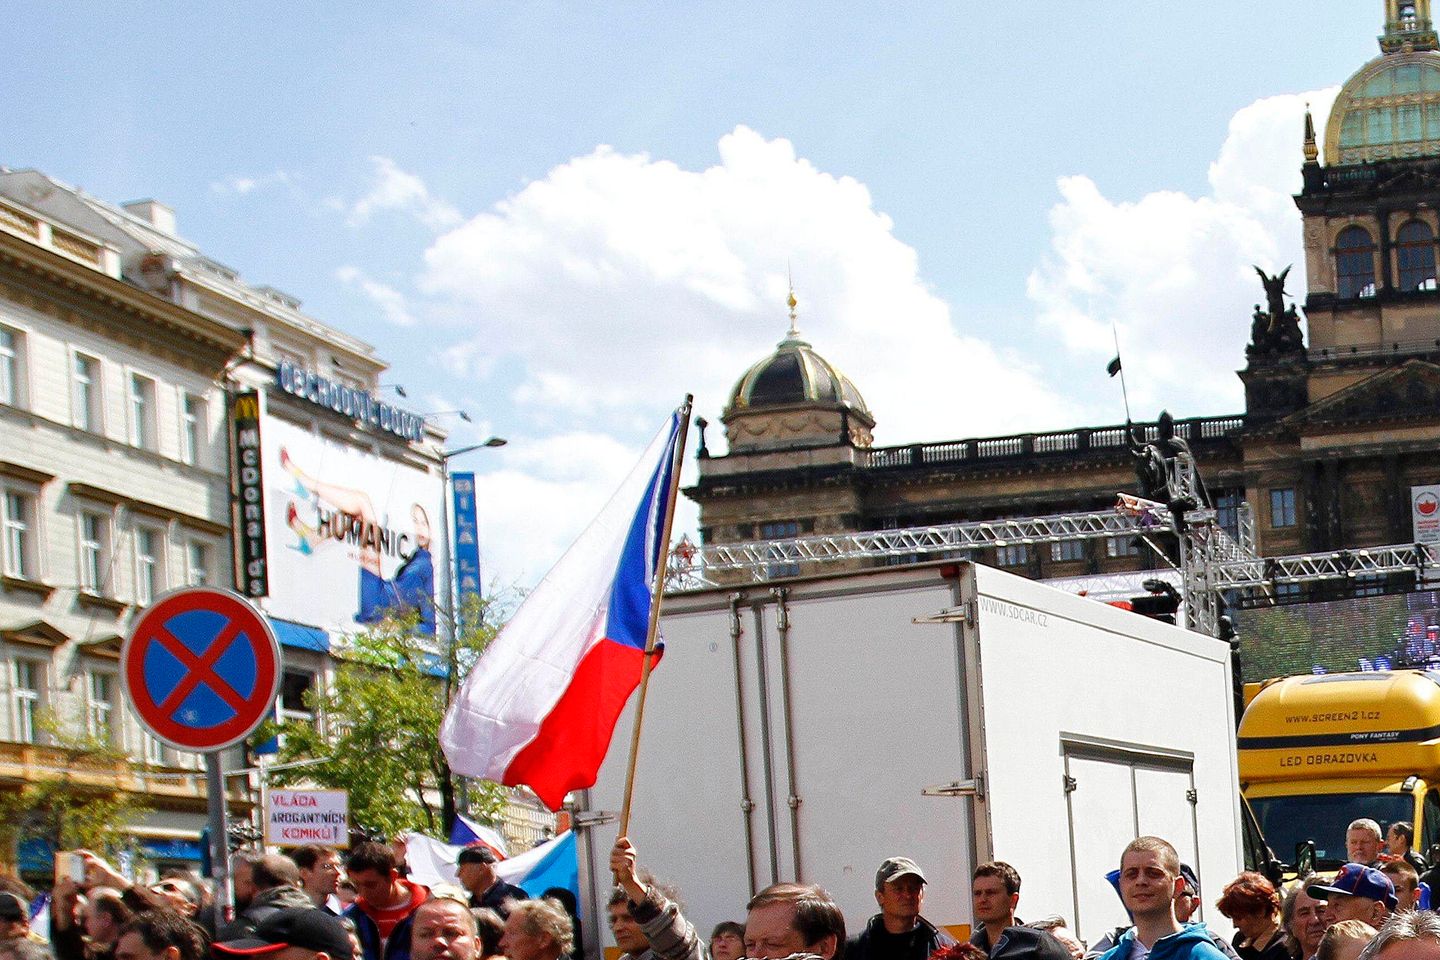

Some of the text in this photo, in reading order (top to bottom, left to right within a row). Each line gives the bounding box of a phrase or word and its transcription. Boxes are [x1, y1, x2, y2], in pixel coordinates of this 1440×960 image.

[316, 506, 412, 561] HUMANIC
[979, 598, 1048, 628] WWW.SDCAR.CZ
[1280, 752, 1378, 767] LED OBRAZOVKA
